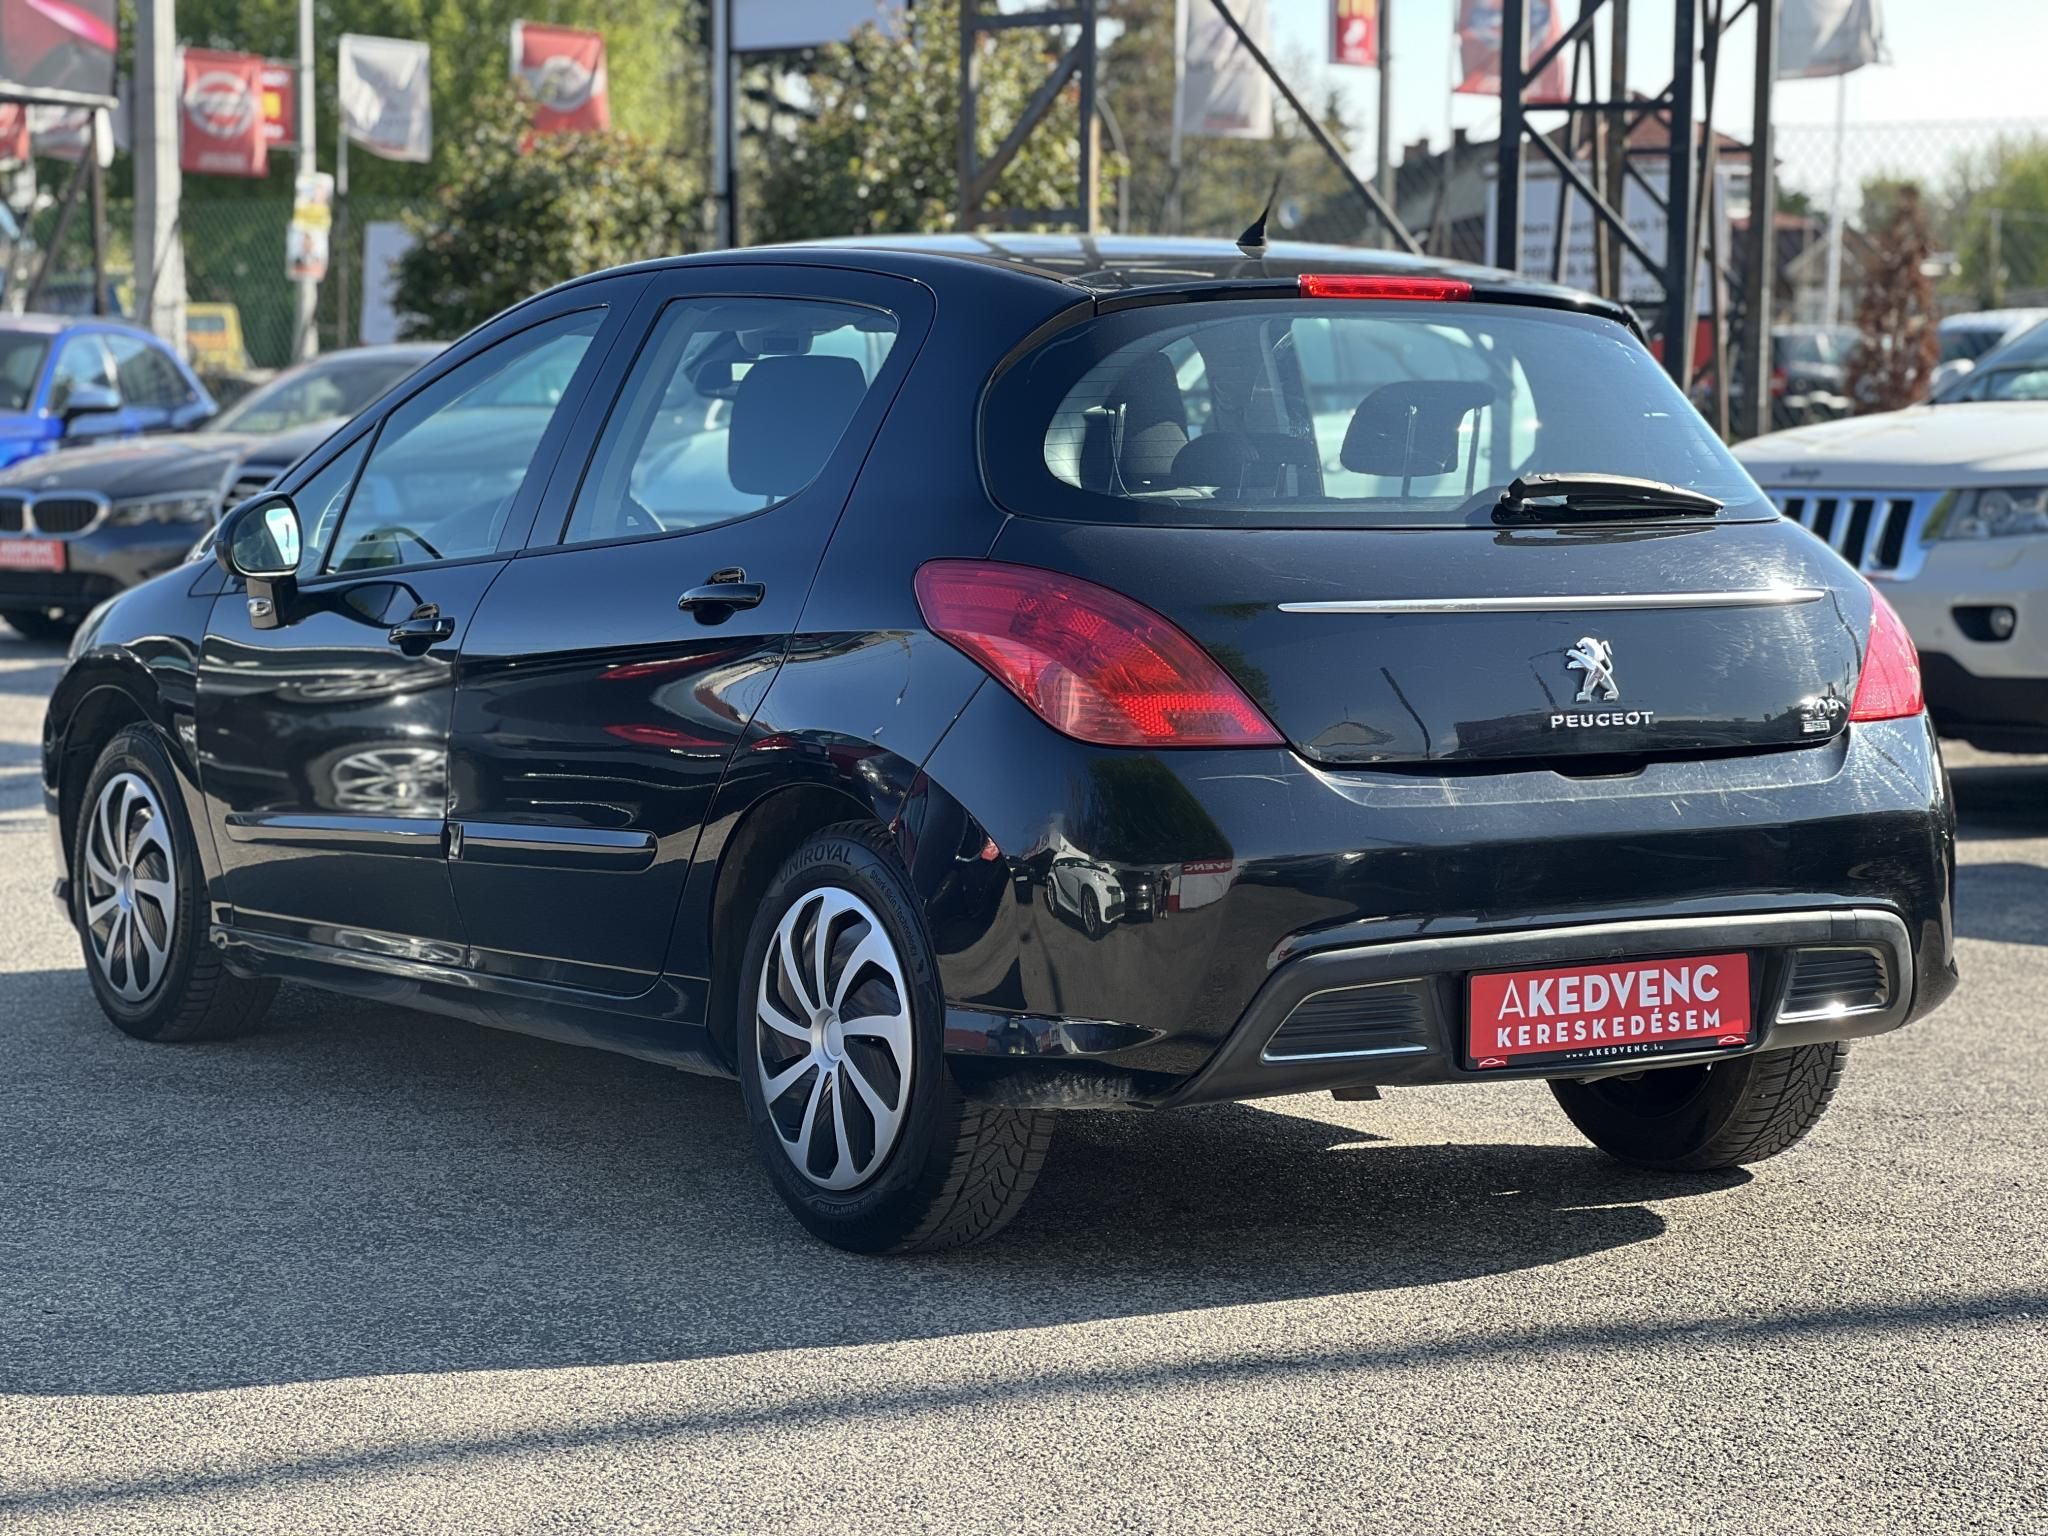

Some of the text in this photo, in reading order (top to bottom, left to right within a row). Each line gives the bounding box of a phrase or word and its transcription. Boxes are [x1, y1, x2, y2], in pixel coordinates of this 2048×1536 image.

[1550, 711, 1654, 728] PEUGEOT
[780, 843, 852, 883] UNIROYAL
[1497, 964, 1721, 1020] AKEDVENC
[1496, 1007, 1721, 1048] KERESKEDÉSEM
